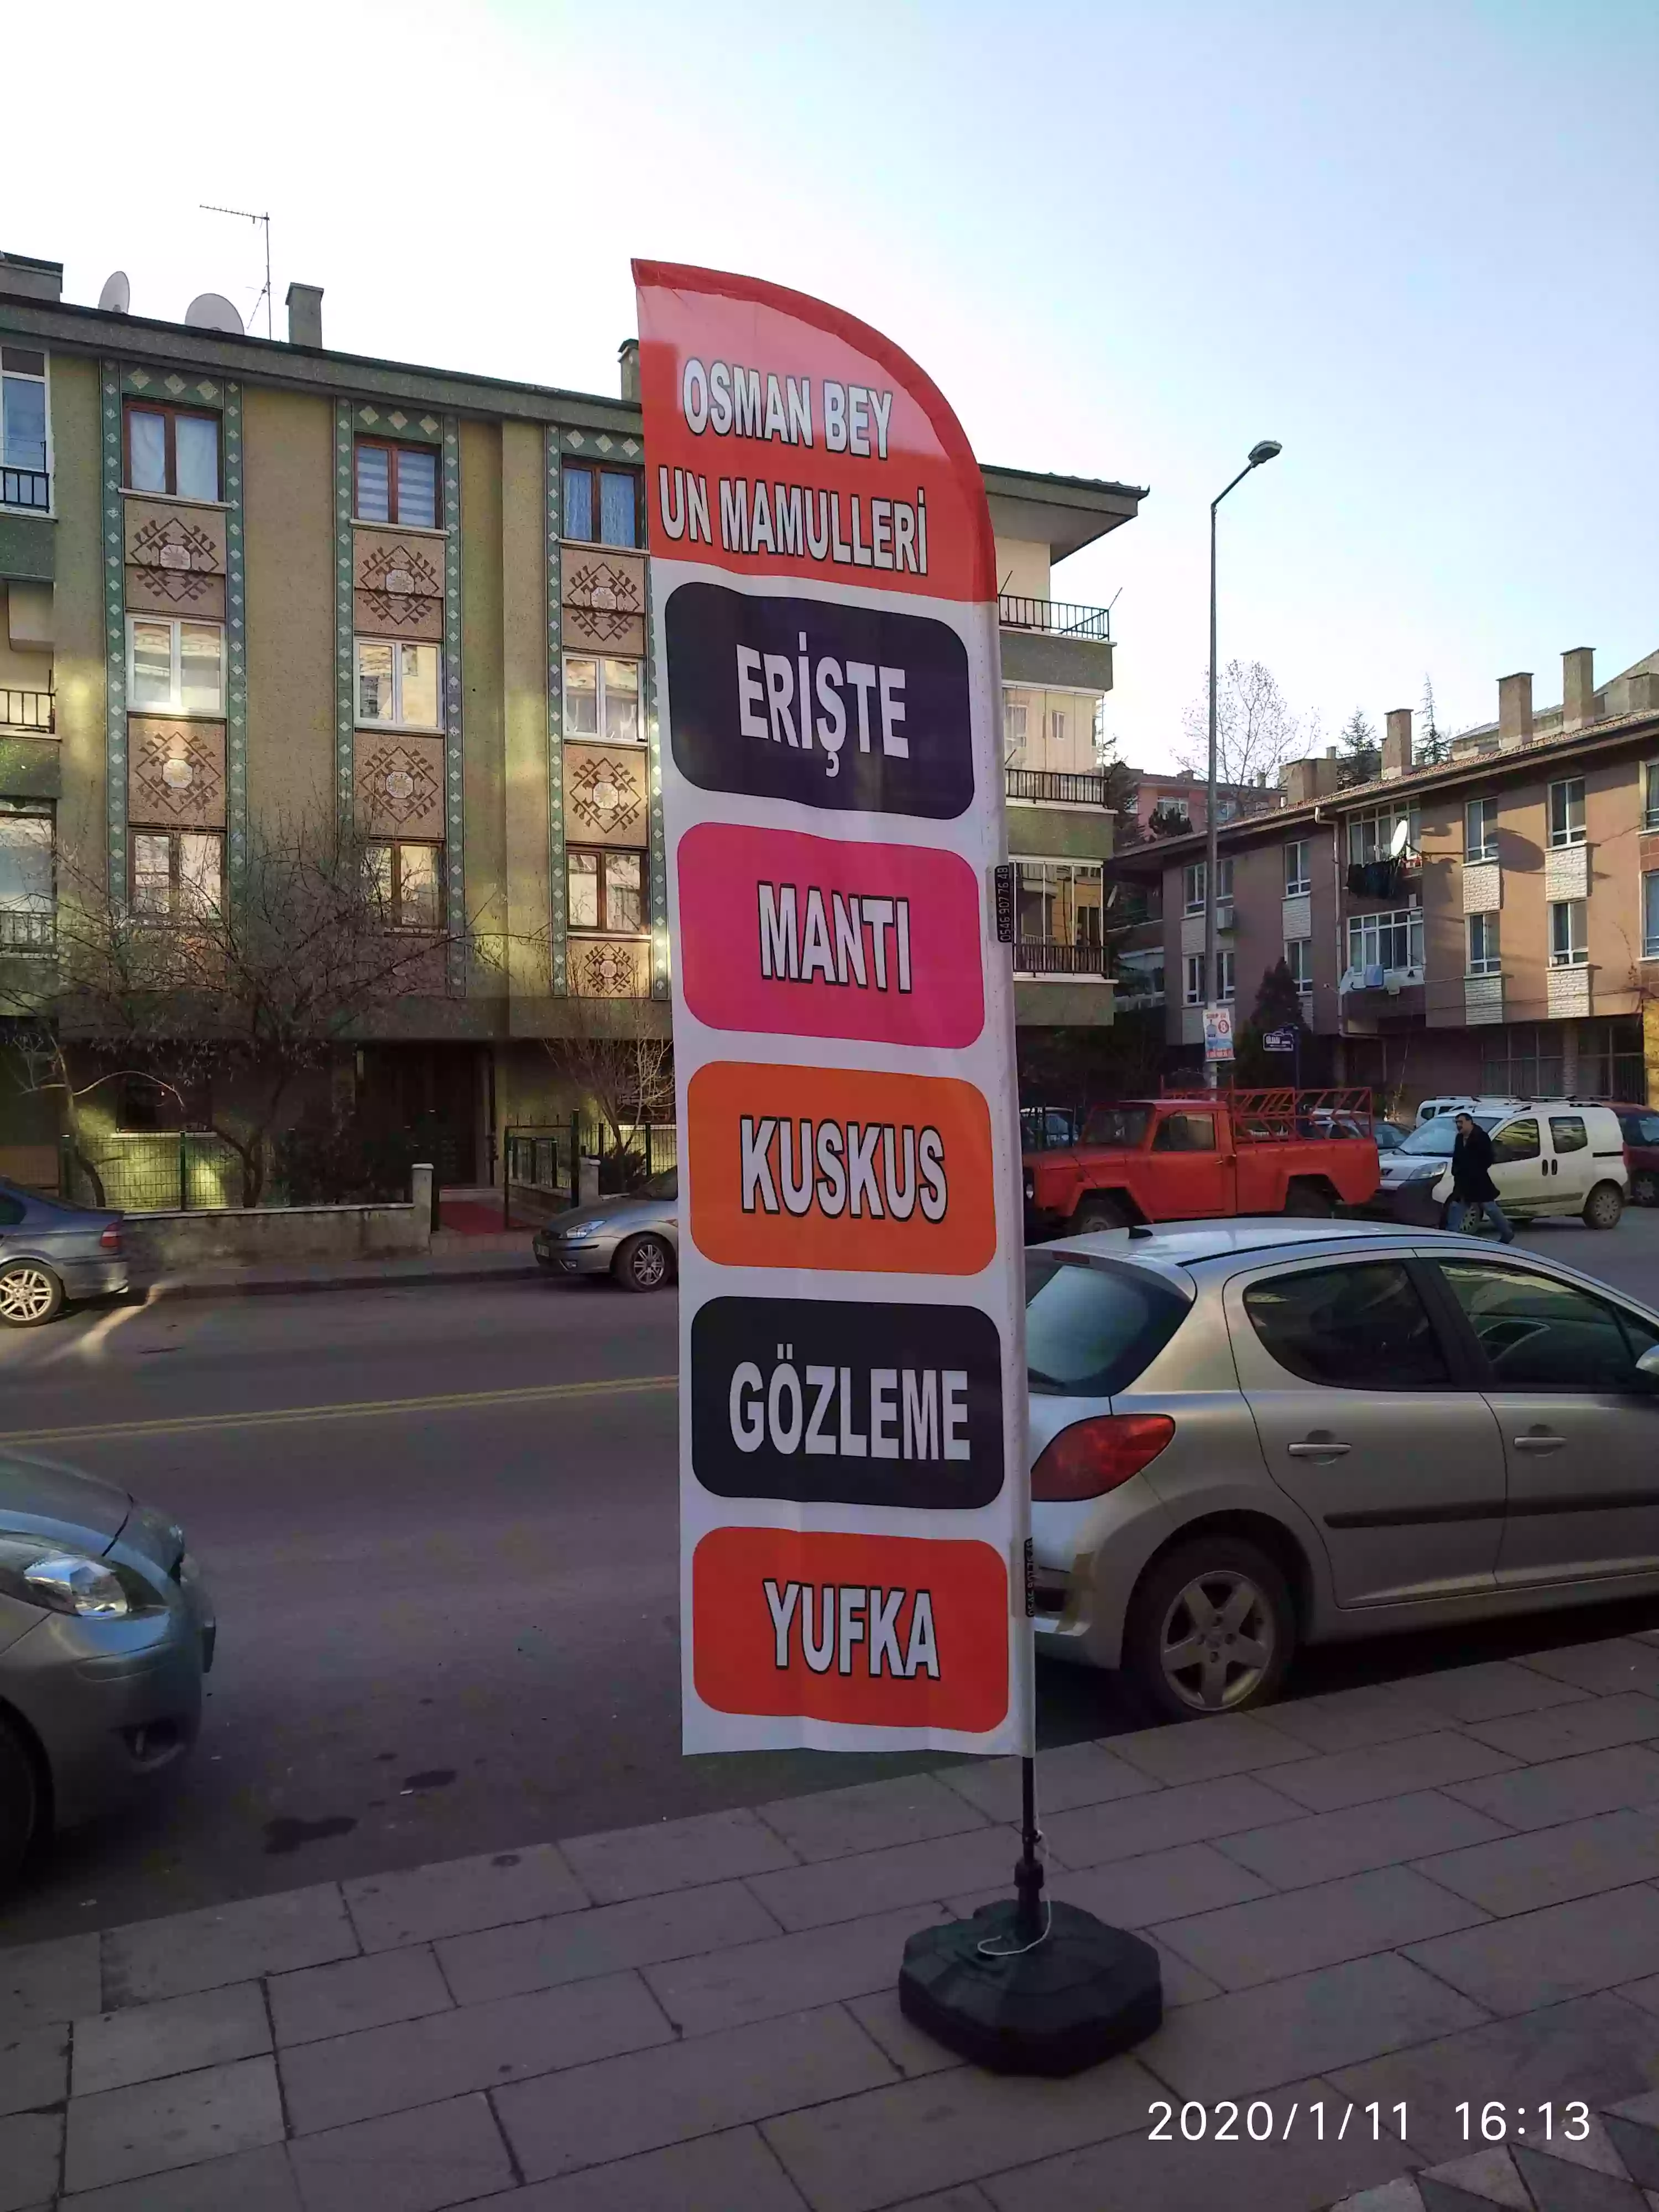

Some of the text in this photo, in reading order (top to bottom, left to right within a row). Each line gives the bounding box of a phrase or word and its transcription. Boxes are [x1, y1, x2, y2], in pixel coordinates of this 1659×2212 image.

[682, 358, 893, 459] OSMAN BEY
[659, 465, 928, 576] UN MAMULLERİ
[736, 632, 909, 778] ERİŞTE
[758, 880, 912, 994] MANTI
[998, 883, 1009, 894] 76
[999, 897, 1010, 914] 907
[1000, 916, 1011, 941] 0546
[740, 1115, 948, 1224] KUSKUS
[729, 1343, 970, 1460] GÖZLEME
[763, 1578, 941, 1681] YUFKA
